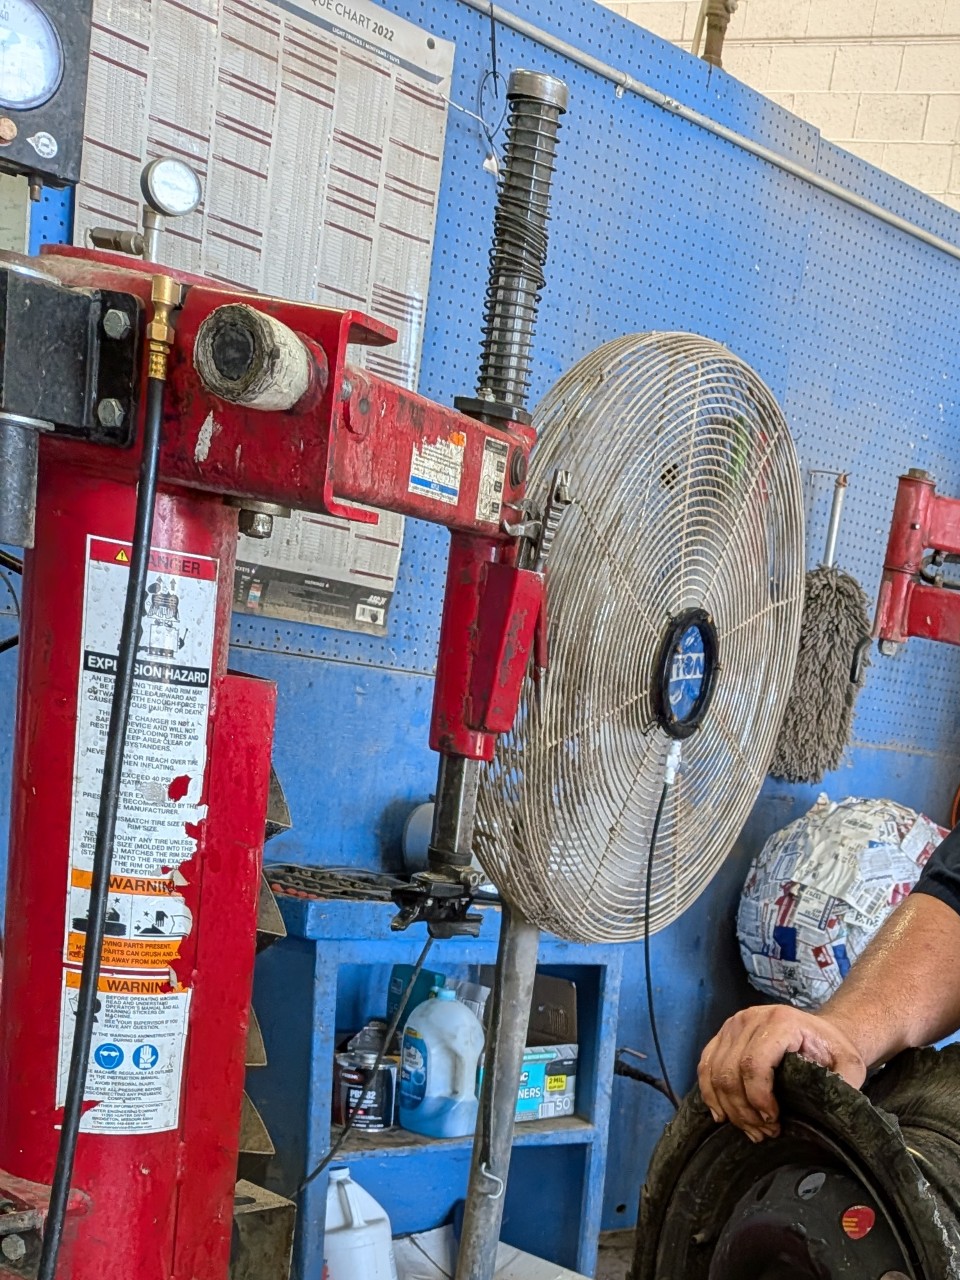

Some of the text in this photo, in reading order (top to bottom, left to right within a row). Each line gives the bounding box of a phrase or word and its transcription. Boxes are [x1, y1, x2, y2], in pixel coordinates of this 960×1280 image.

[335, 3, 371, 30] CHART
[372, 22, 395, 42] 2022
[332, 27, 346, 37] LIGHT
[345, 32, 363, 45] TRUCKS
[365, 41, 387, 57] MINIVANS
[88, 655, 207, 684] EXPLSION HAZARD
[165, 686, 179, 694] AND
[147, 698, 176, 707] ENOUGH
[135, 716, 169, 725] CHANGER
[129, 729, 169, 739] EXPLODING
[163, 739, 183, 747] CLEAR
[146, 756, 169, 764] REACH
[122, 772, 151, 781] EXCEED
[135, 843, 165, 851] (MOLDED
[121, 849, 154, 857] MATCHES
[110, 877, 175, 893] WARNIN
[104, 949, 124, 957] PARTS
[107, 980, 164, 993] WARNIN
[556, 1098, 571, 1111] 50
